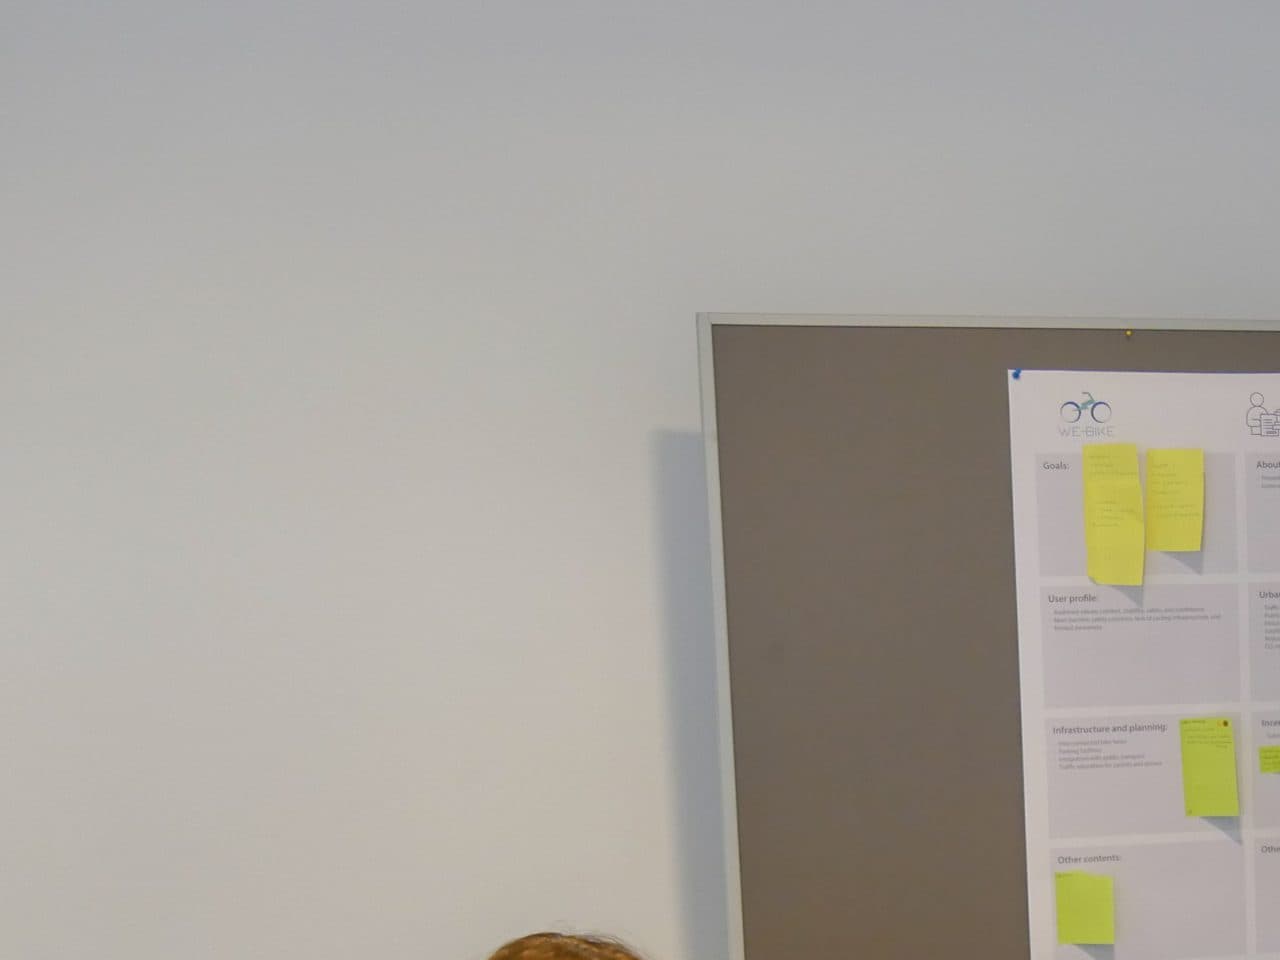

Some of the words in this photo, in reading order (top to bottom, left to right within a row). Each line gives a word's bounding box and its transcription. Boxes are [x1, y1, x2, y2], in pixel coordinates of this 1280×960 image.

[1043, 460, 1070, 471] Goals:
[1256, 460, 1280, 469] About
[1048, 594, 1067, 603] User
[1053, 725, 1109, 735] Infrastructure
[1111, 724, 1128, 733] and
[1057, 855, 1082, 865] Other
